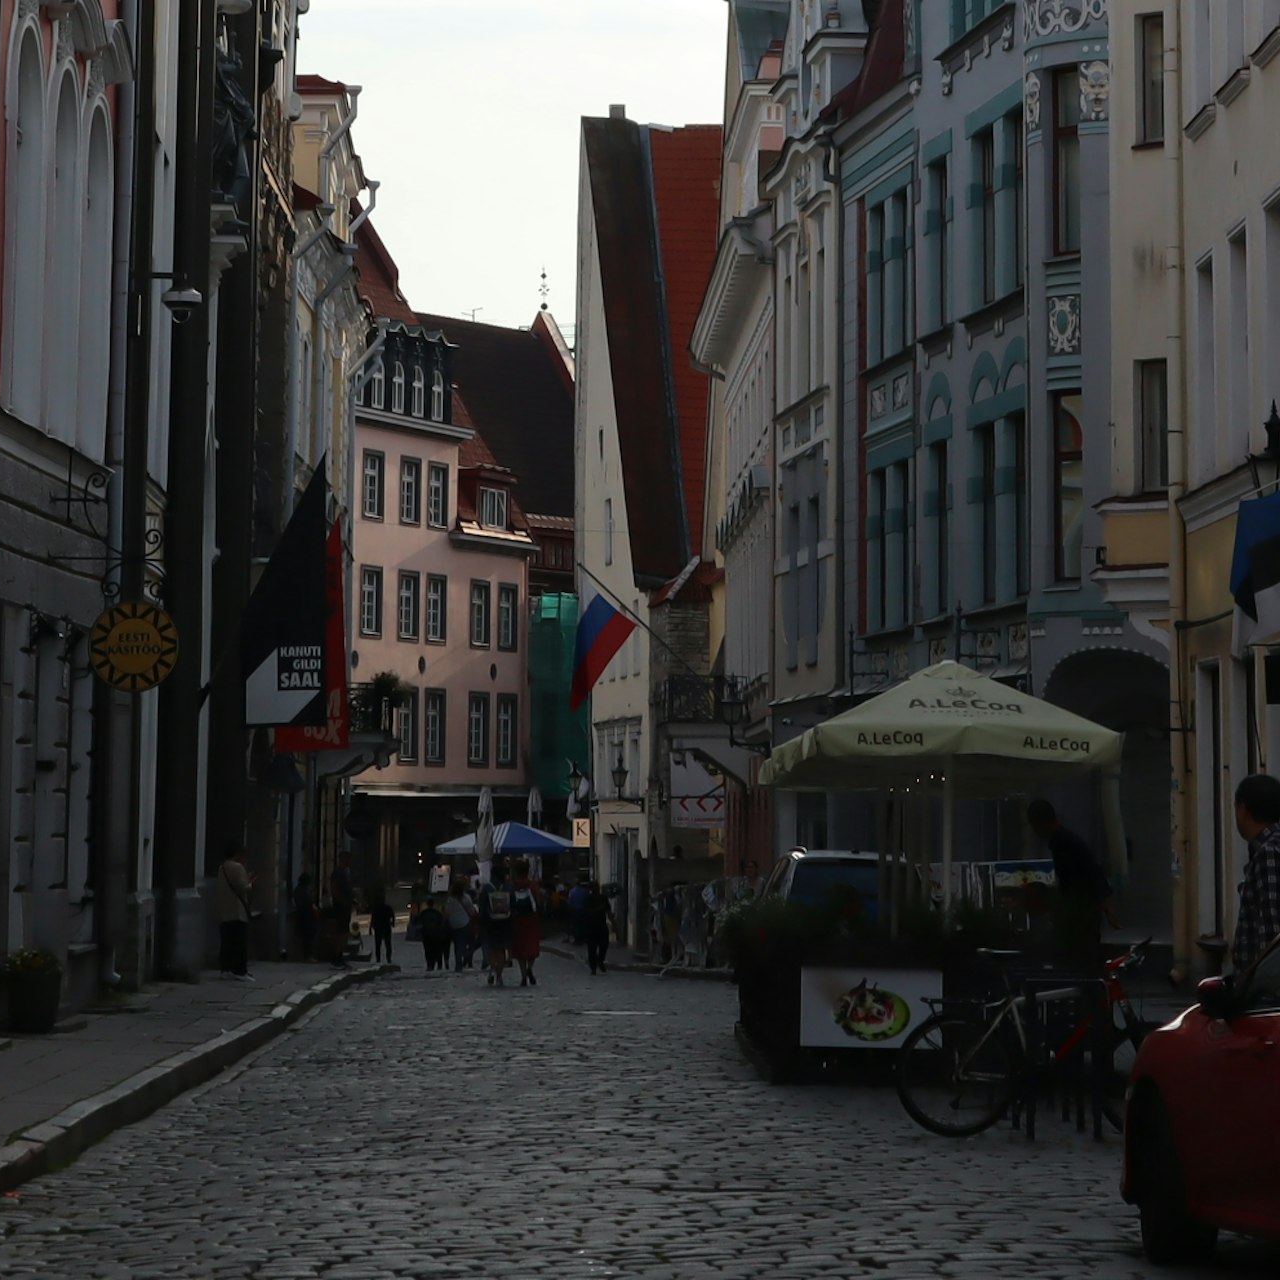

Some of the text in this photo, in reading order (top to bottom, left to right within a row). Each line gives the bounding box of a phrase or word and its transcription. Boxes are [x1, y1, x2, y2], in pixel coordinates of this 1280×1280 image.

[118, 632, 151, 643] EESTI
[280, 646, 322, 658] KANUTI
[292, 658, 322, 670] GILDI
[280, 672, 322, 688] SAAL
[576, 821, 588, 837] K
